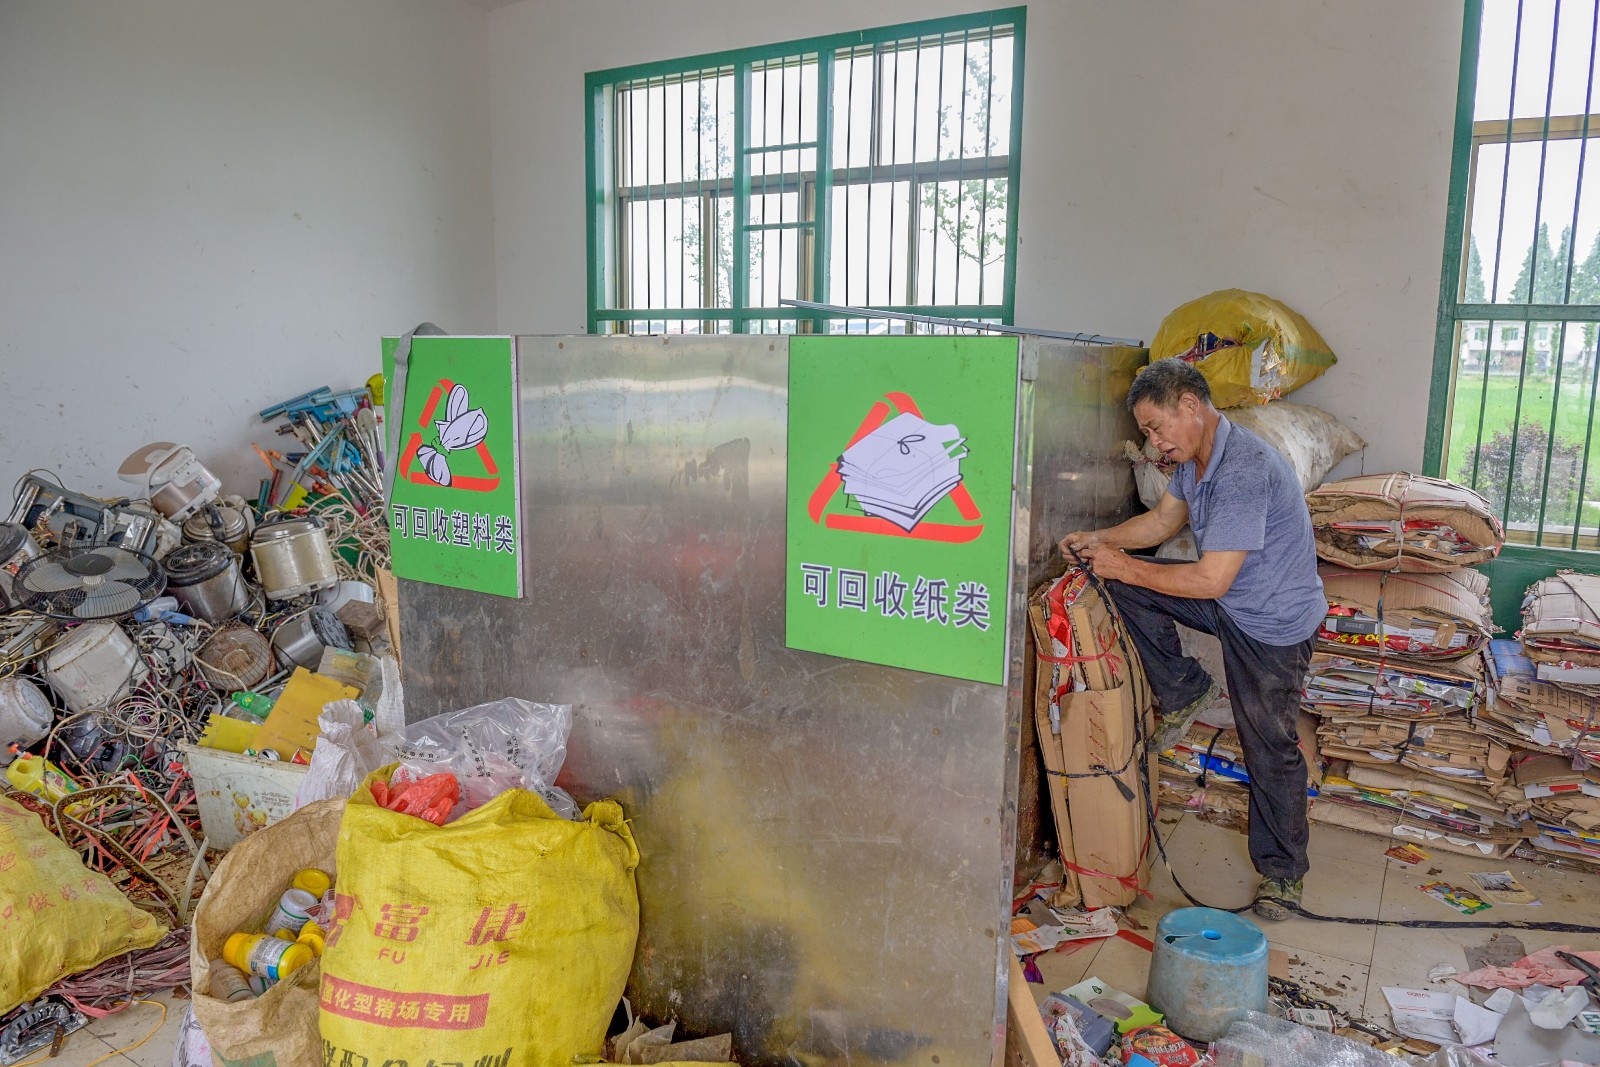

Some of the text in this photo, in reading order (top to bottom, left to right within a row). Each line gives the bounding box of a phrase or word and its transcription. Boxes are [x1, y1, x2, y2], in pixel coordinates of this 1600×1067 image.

[392, 503, 515, 555] 可回收塑料类
[800, 562, 991, 632] 可回收纸类
[377, 947, 511, 970] FU JIE
